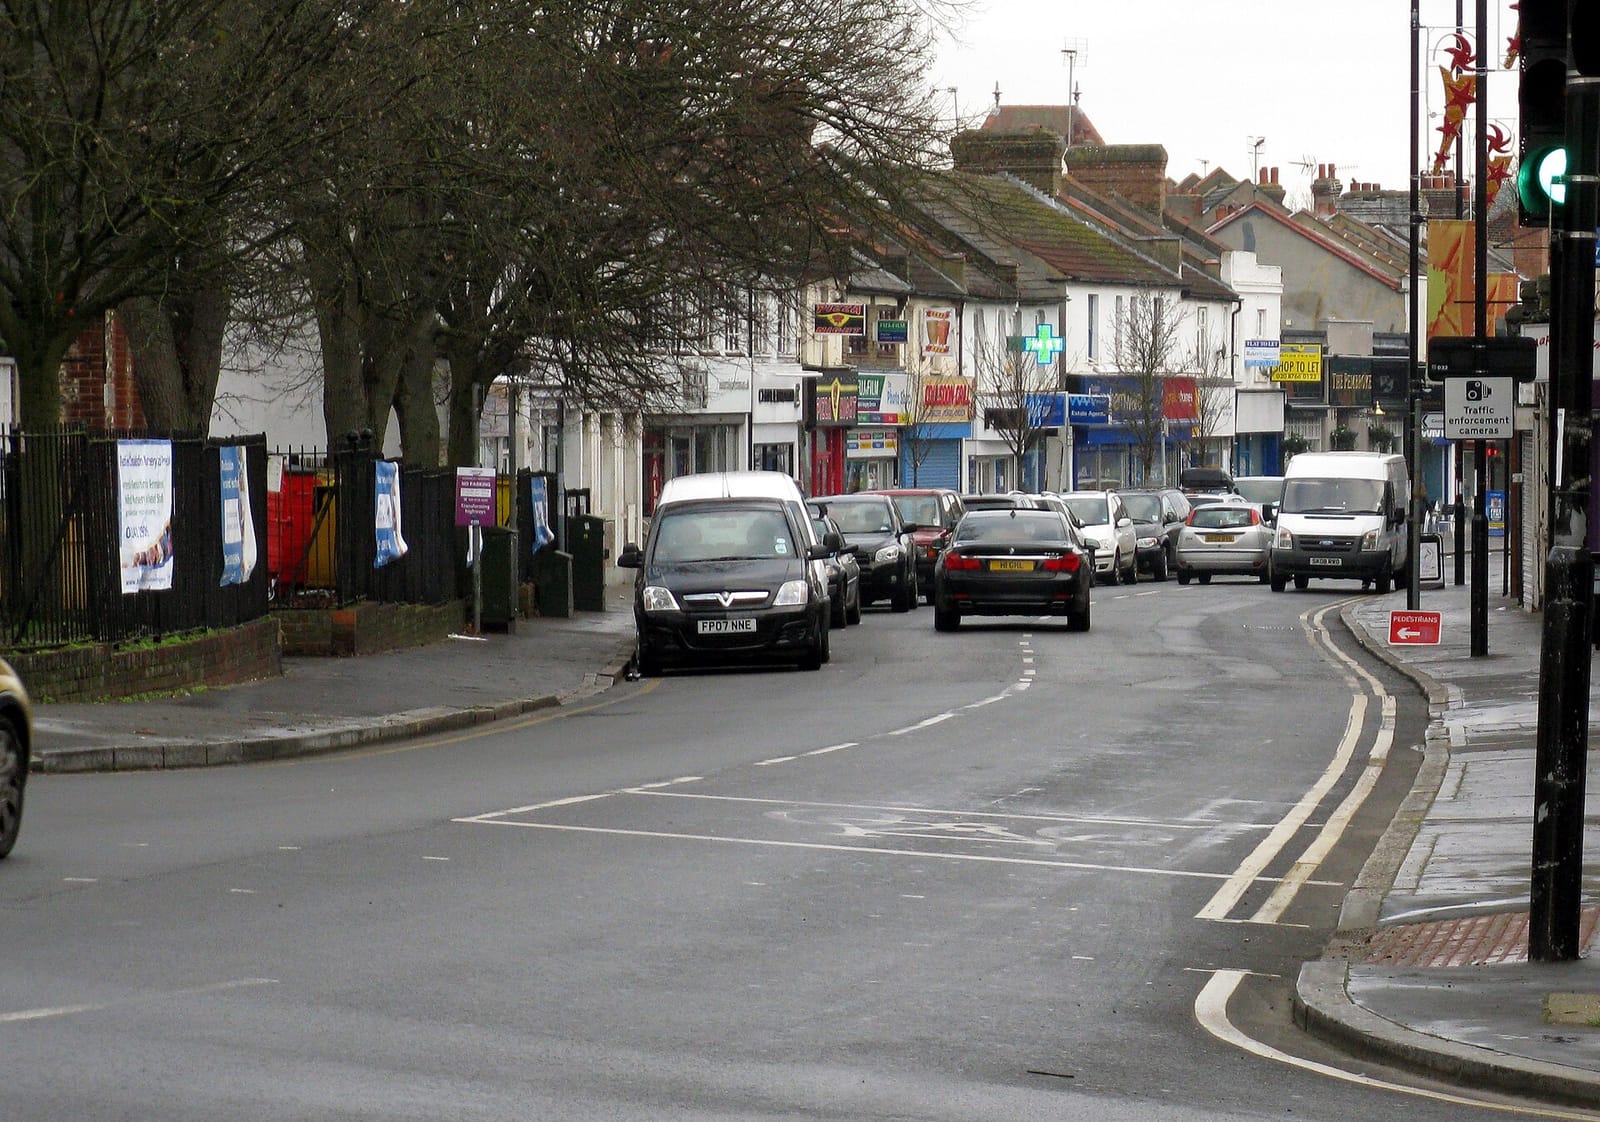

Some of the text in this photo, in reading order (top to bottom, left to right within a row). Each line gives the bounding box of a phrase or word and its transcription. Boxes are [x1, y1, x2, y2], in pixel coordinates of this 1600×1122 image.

[1296, 362, 1305, 372] TO
[1307, 362, 1319, 373] LET
[1464, 405, 1494, 414] Traffic
[1449, 416, 1509, 425] enforcement
[1459, 427, 1499, 435] cameras
[1393, 615, 1438, 624] PEDESTRIANS
[702, 620, 752, 632] FP07 NNE
